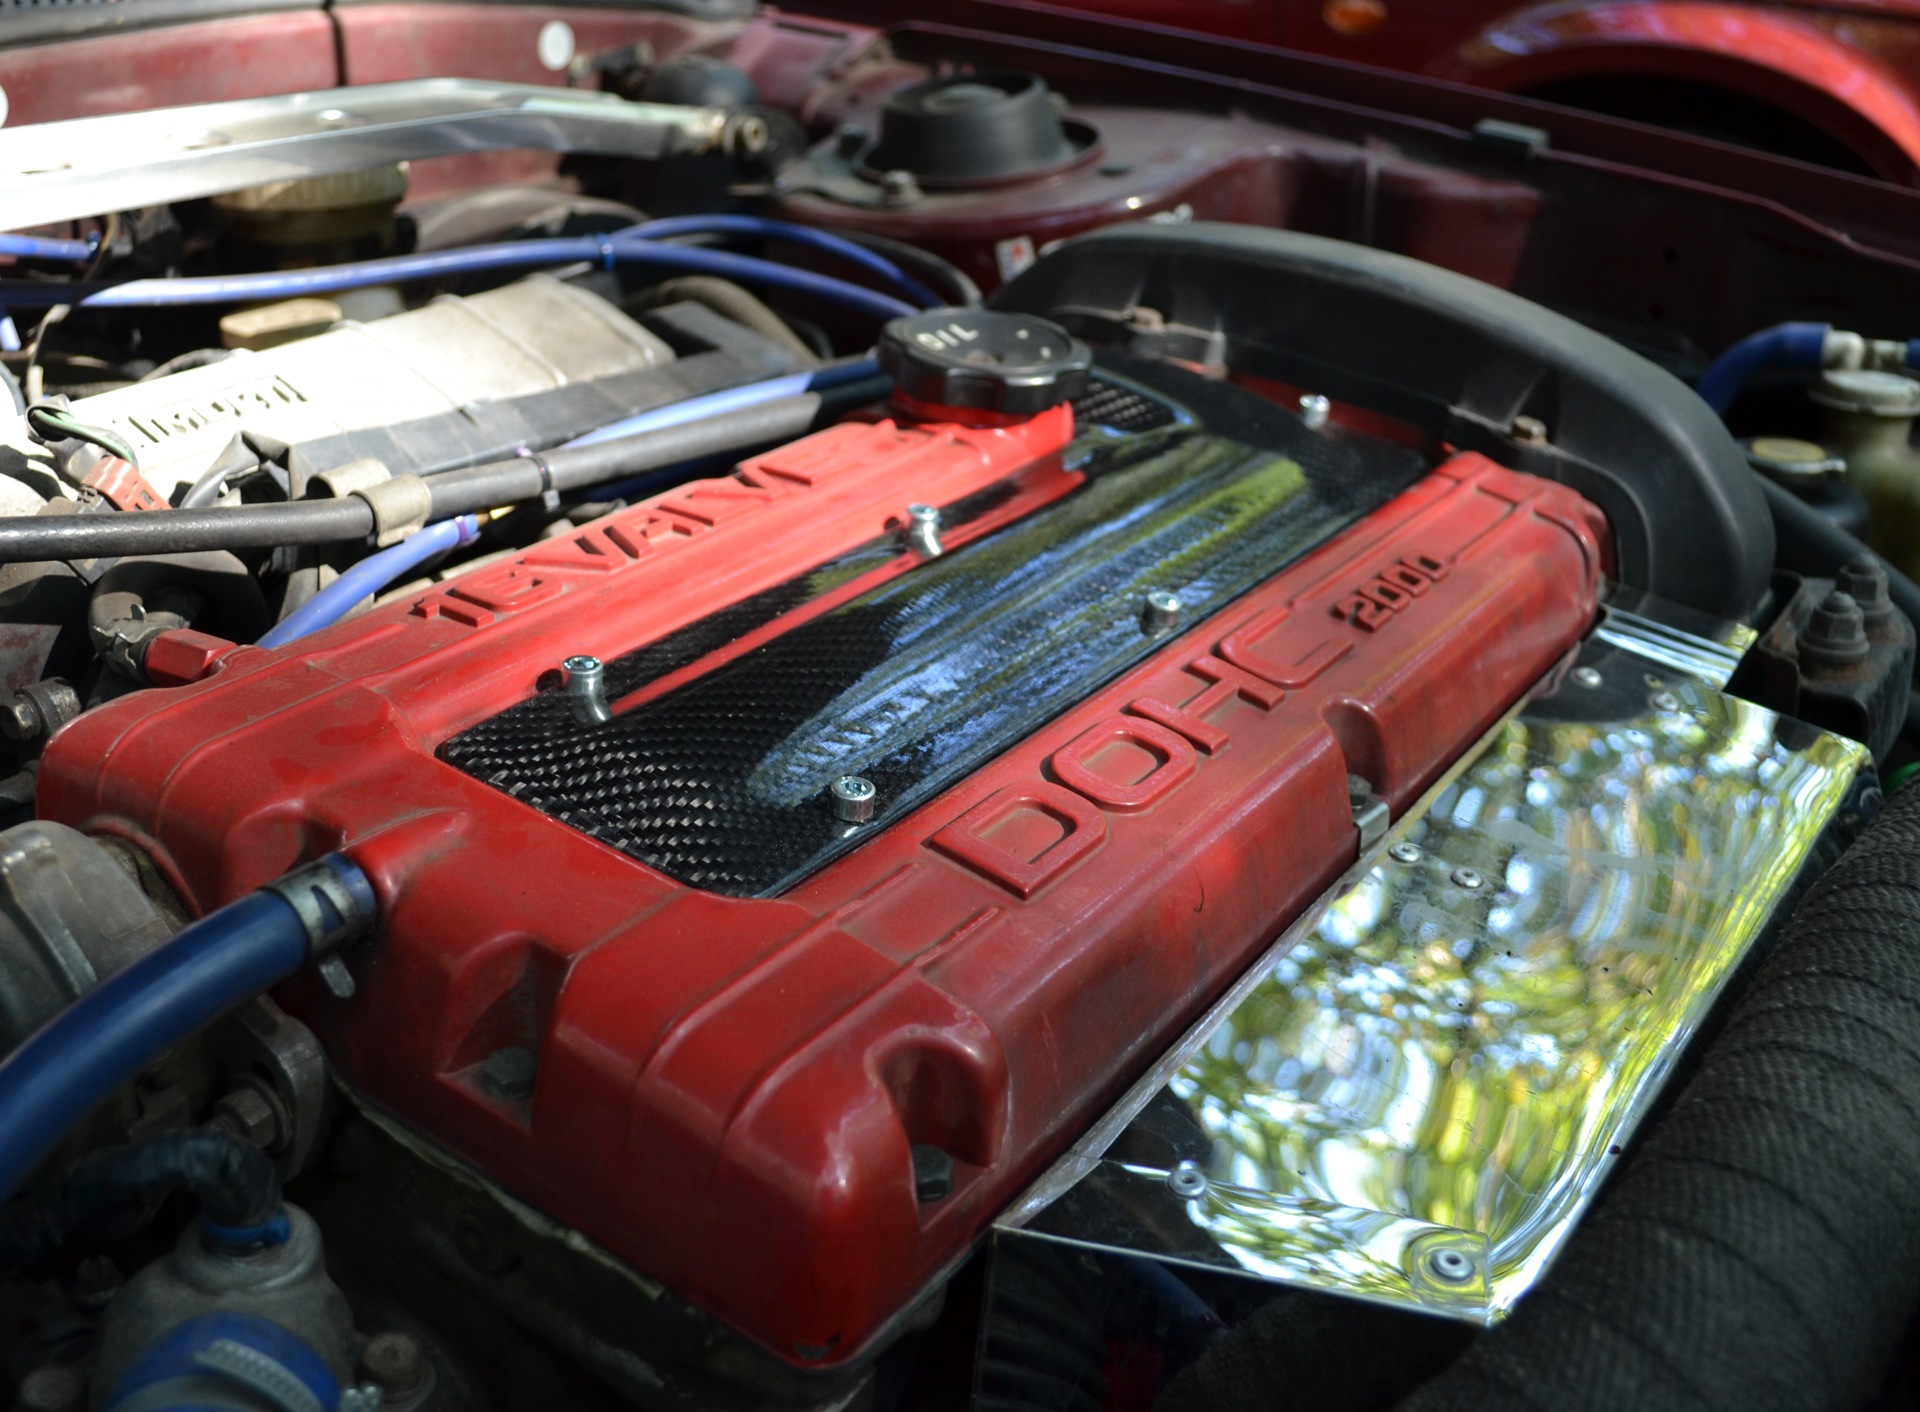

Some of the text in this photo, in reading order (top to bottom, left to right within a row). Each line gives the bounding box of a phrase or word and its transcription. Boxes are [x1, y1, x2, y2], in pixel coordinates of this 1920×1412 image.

[915, 322, 979, 351] OIL
[924, 552, 1454, 901] DOHC 2000
